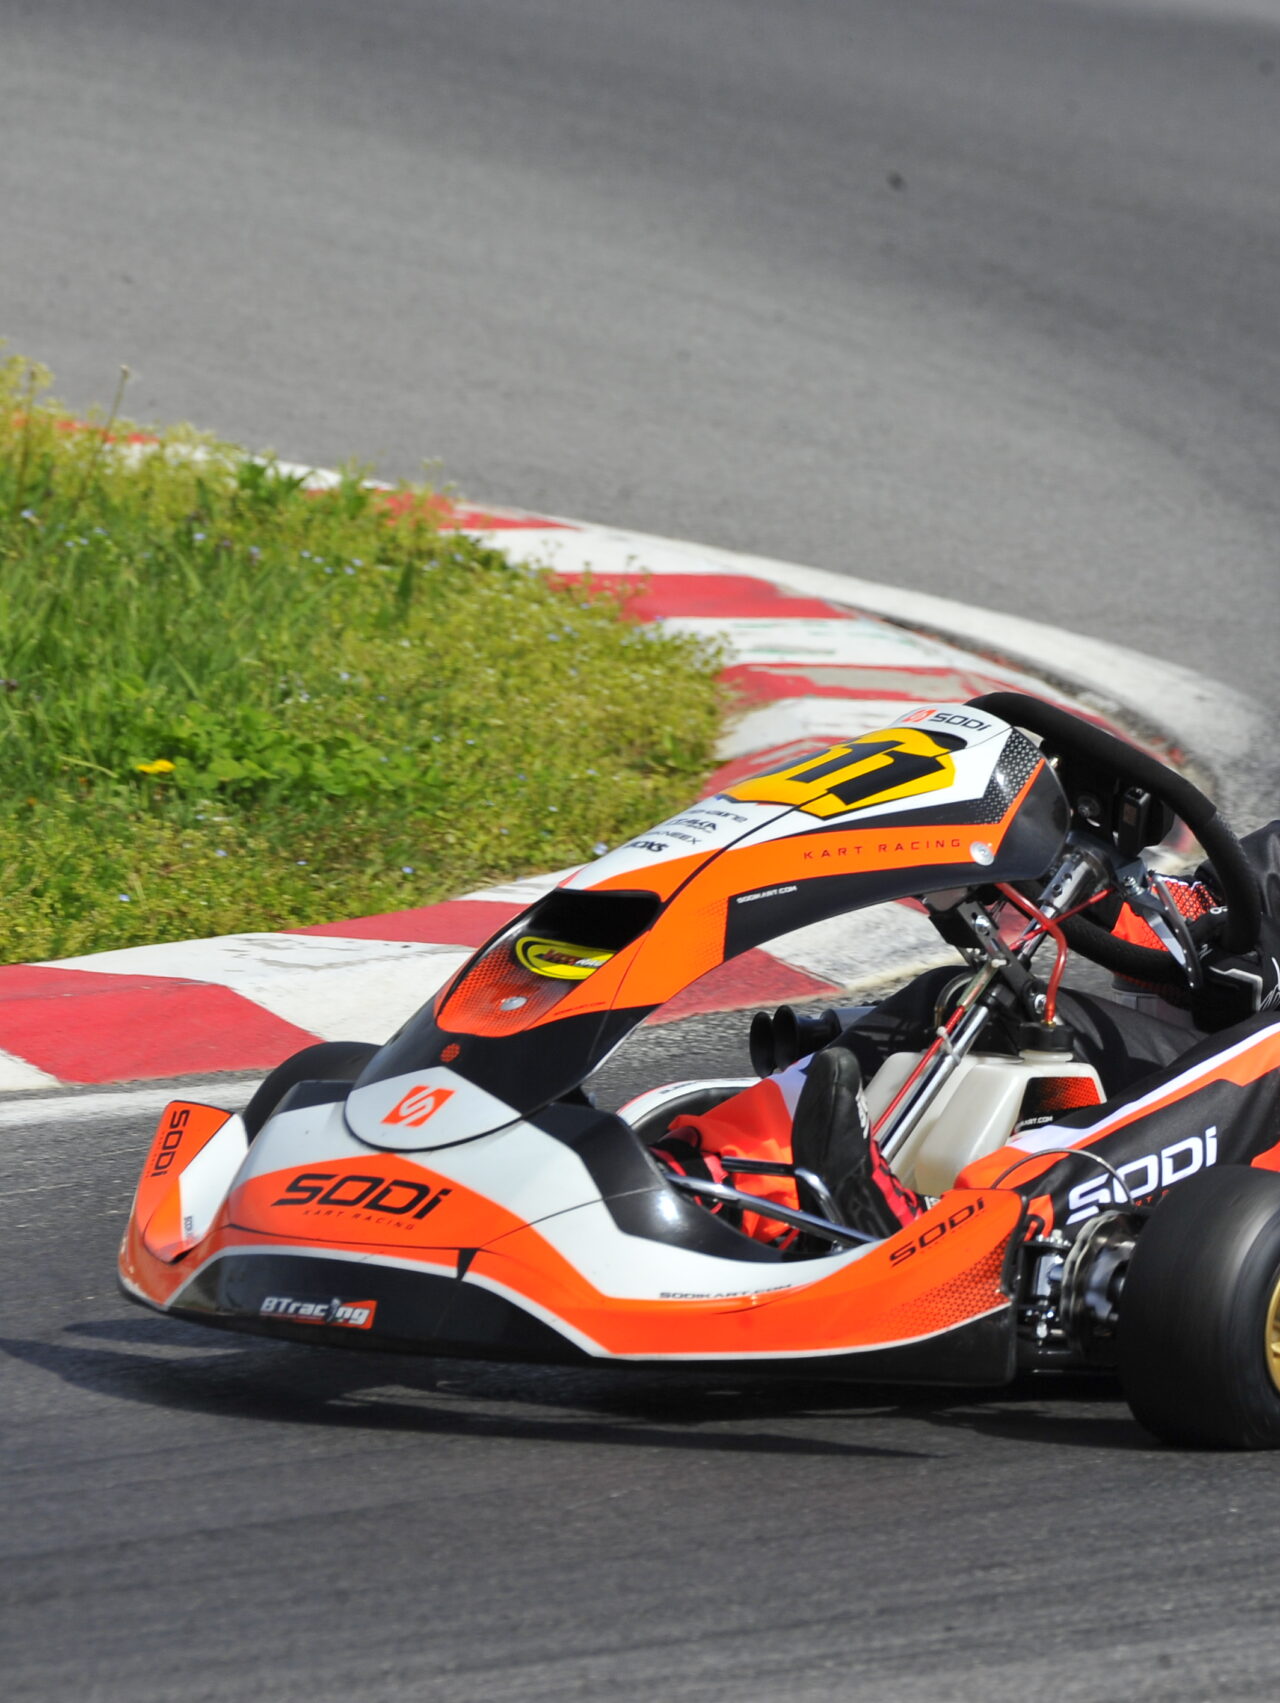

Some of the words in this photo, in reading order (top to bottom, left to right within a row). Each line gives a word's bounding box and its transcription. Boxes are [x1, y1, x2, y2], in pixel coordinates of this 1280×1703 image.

[803, 845, 863, 860] KART
[878, 838, 962, 853] RACING
[303, 1209, 345, 1217] KART
[351, 1213, 416, 1231] RACING
